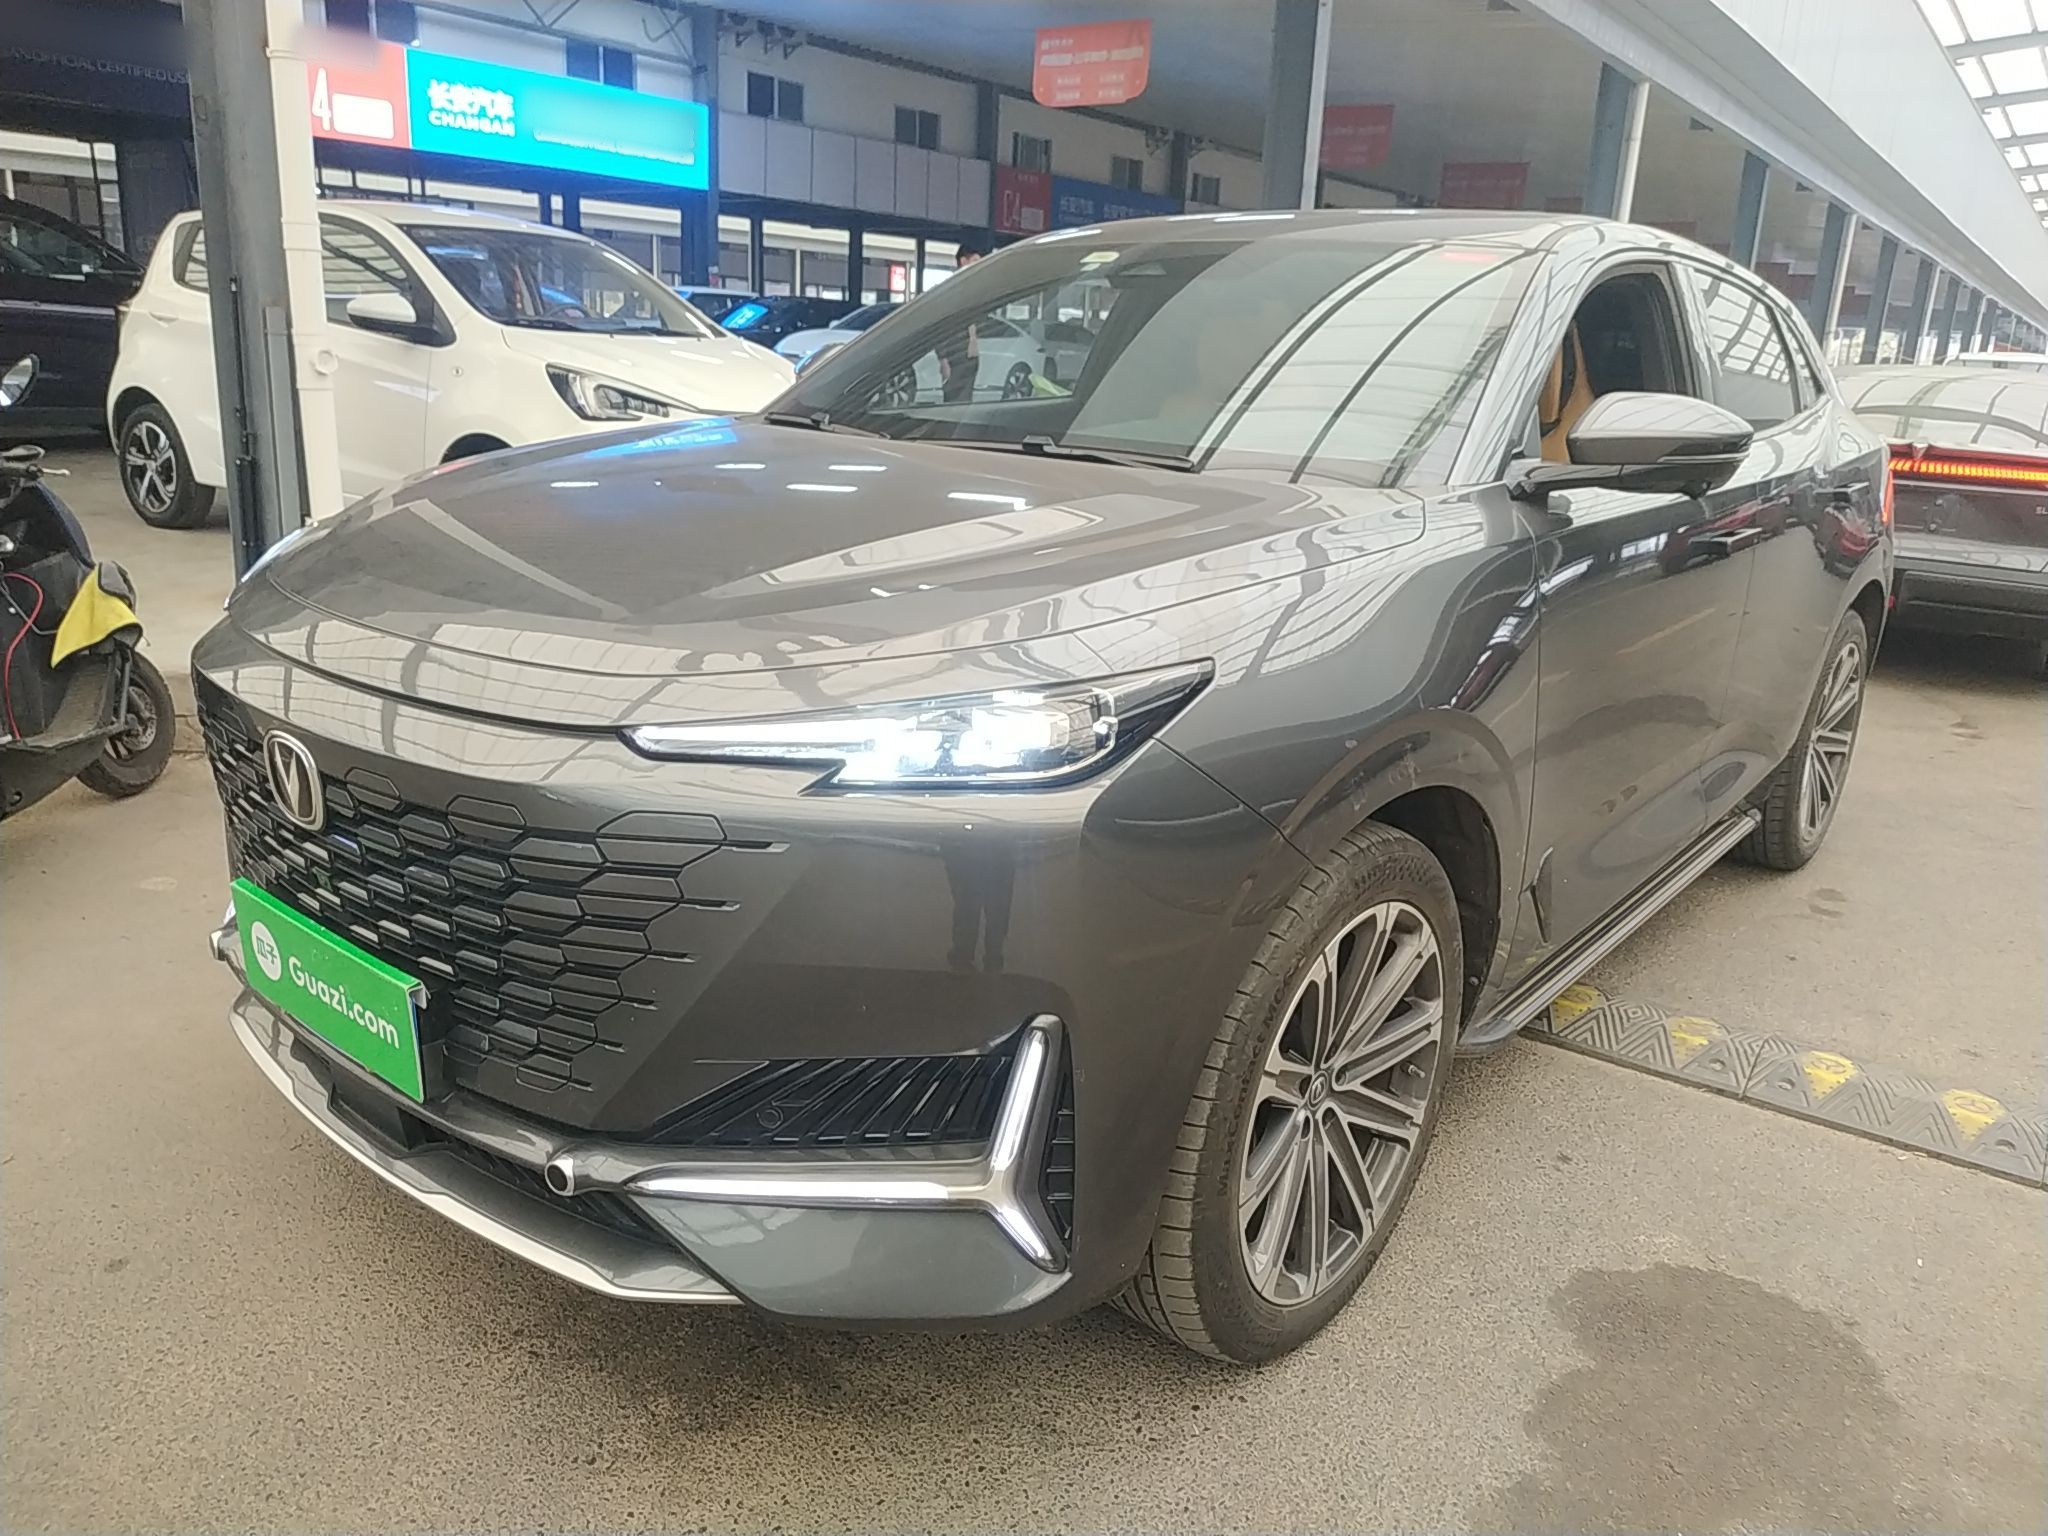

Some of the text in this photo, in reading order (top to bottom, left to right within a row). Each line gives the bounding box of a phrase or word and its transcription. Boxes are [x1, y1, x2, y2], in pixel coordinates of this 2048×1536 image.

[428, 110, 516, 137] CHANGAN
[256, 936, 277, 965] 瓜子
[289, 956, 399, 1049] Guazi.com
